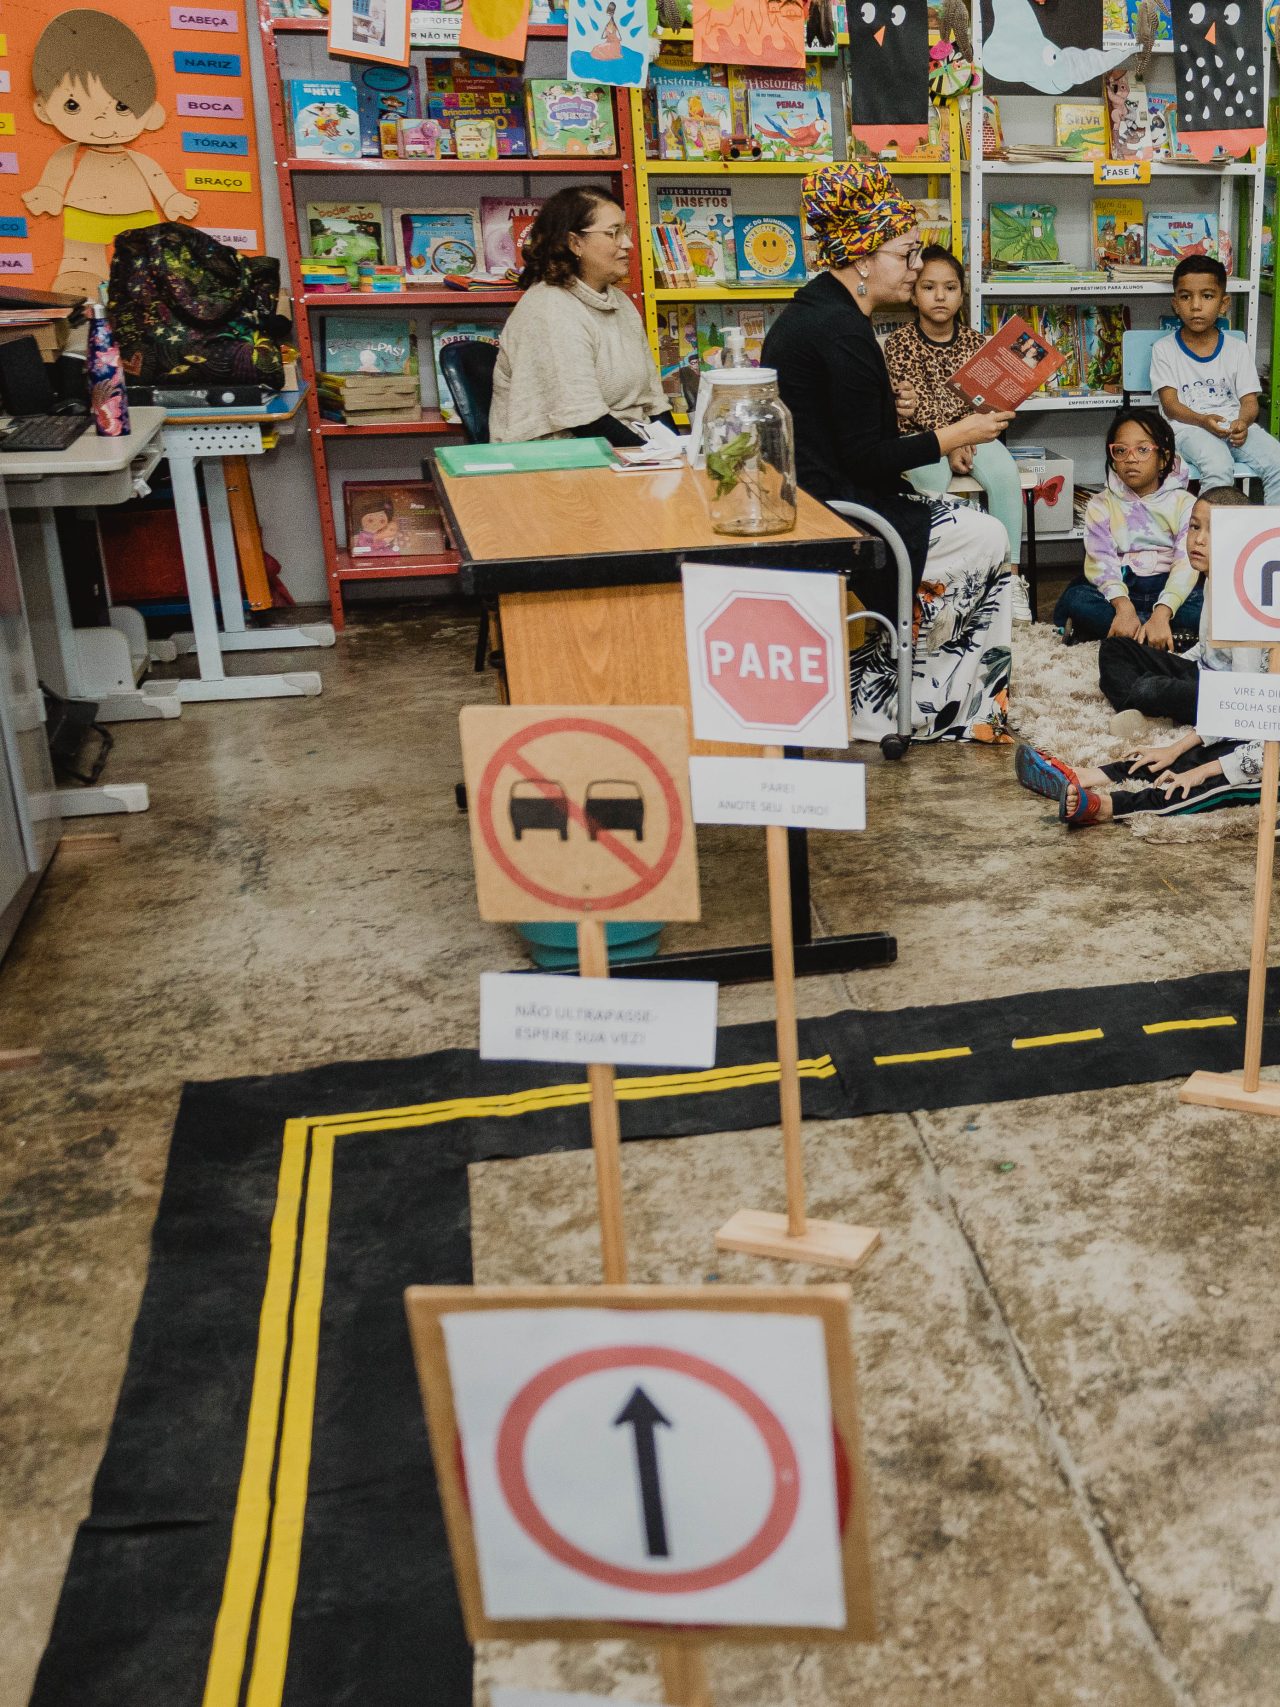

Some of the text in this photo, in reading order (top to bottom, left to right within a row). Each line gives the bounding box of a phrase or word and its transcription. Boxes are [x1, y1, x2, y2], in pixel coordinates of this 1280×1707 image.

[178, 14, 230, 27] CABEÇA
[420, 31, 440, 40] NÃO
[184, 58, 233, 69] NARIZ
[188, 101, 233, 112] BOCA
[442, 108, 482, 117] Brincando
[192, 137, 239, 150] TÓRAX
[1106, 168, 1130, 177] FASE
[193, 176, 244, 189] BRAÇO
[686, 188, 728, 196] DIVERTIDO
[675, 196, 729, 208] INSETOS
[742, 217, 796, 235] ABC DO MUNDINHO
[710, 640, 825, 684] PARE
[1233, 687, 1256, 697] VIRE
[1257, 687, 1265, 697] A
[1218, 701, 1265, 713] ESCOLHA
[1233, 718, 1255, 729] BOA
[760, 782, 797, 794] PARE!
[717, 799, 830, 816] ANOTE SEU LIVRO!
[514, 1002, 551, 1018] NÃO
[514, 1026, 648, 1045] ESPERE SUA VEZ!
